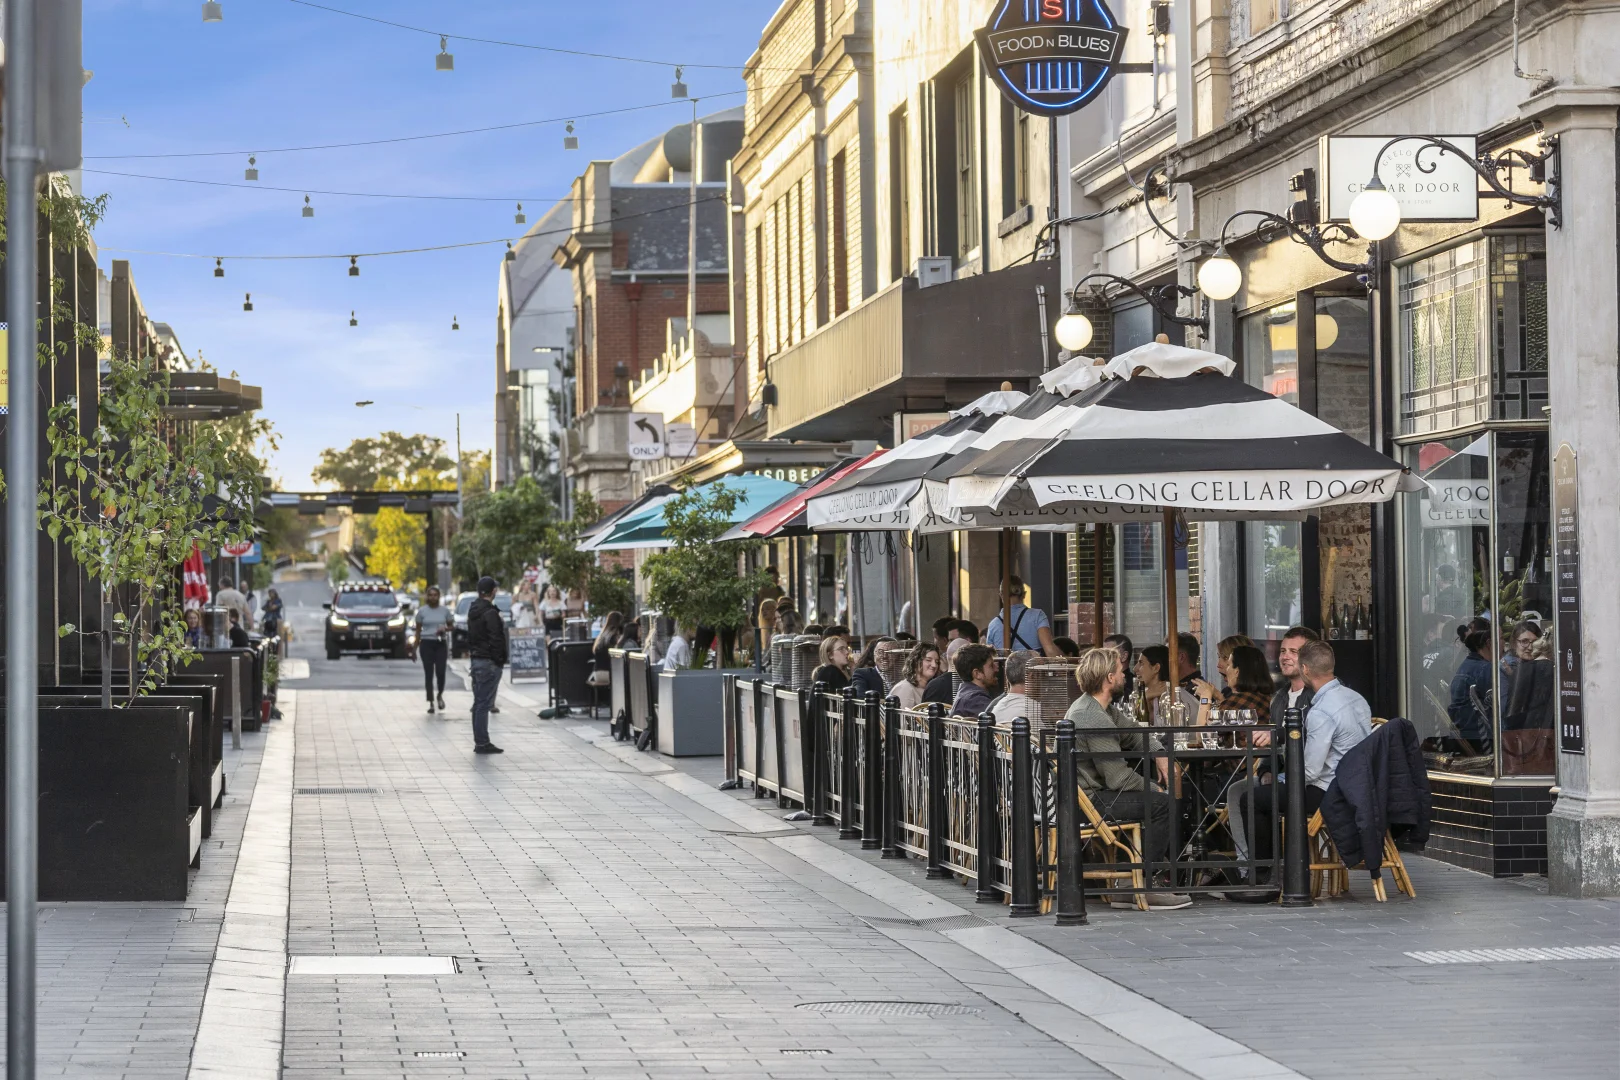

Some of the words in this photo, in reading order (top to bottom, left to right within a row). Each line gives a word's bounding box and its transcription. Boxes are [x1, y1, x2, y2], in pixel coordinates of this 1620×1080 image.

[997, 35, 1044, 54] FOOD
[1046, 38, 1055, 47] N
[1058, 34, 1110, 52] BLUES
[1347, 182, 1406, 193] CEAR
[1415, 182, 1460, 193] DOOR
[632, 446, 660, 456] ONLY
[1047, 481, 1179, 502] GEELONG
[1190, 480, 1293, 502] CELLAR
[1306, 478, 1385, 501] DOOR
